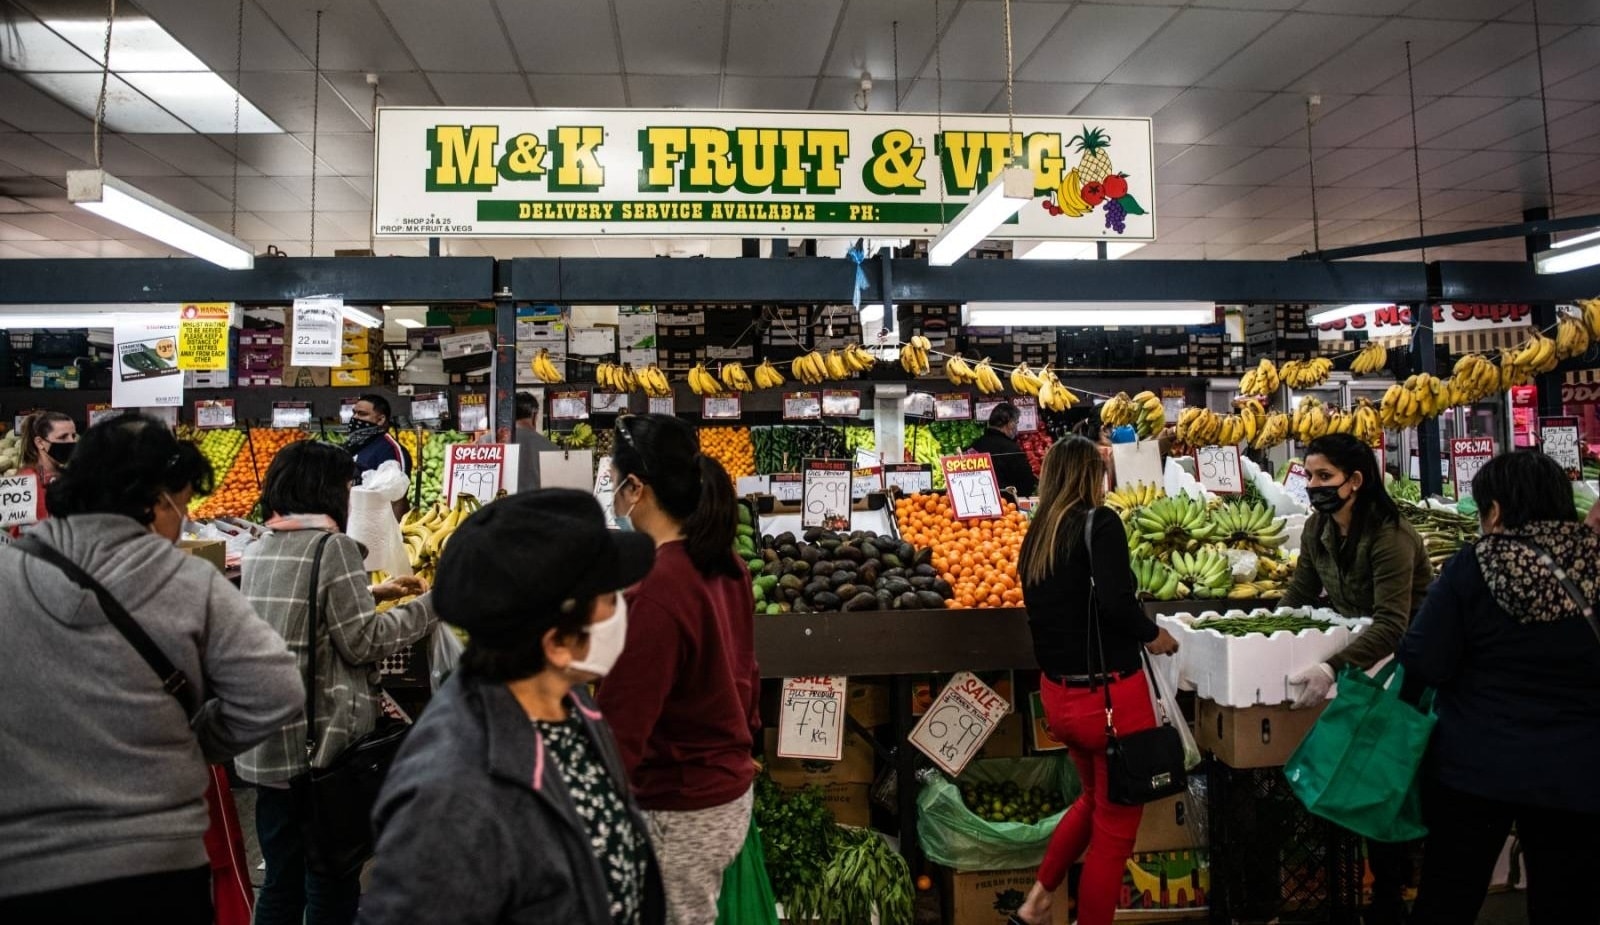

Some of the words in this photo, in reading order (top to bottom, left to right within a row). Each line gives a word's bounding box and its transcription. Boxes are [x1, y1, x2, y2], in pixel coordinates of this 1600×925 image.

[426, 125, 605, 193] M&K
[637, 126, 850, 194] FRUIT
[862, 129, 926, 195] &
[934, 131, 1066, 196] VEG
[519, 202, 614, 219] DELIVERY
[621, 202, 702, 219] SERVICE
[711, 203, 816, 220] AVAILABLE
[849, 204, 880, 221] PH:
[297, 335, 310, 345] 22
[454, 446, 502, 460] SPECIAL
[1454, 440, 1492, 454] SPECIAL
[945, 457, 992, 472] SPECIAL
[0, 477, 28, 489] AVE
[0, 490, 32, 506] POS
[8, 511, 28, 521] MIN
[960, 678, 1000, 711] SALE
